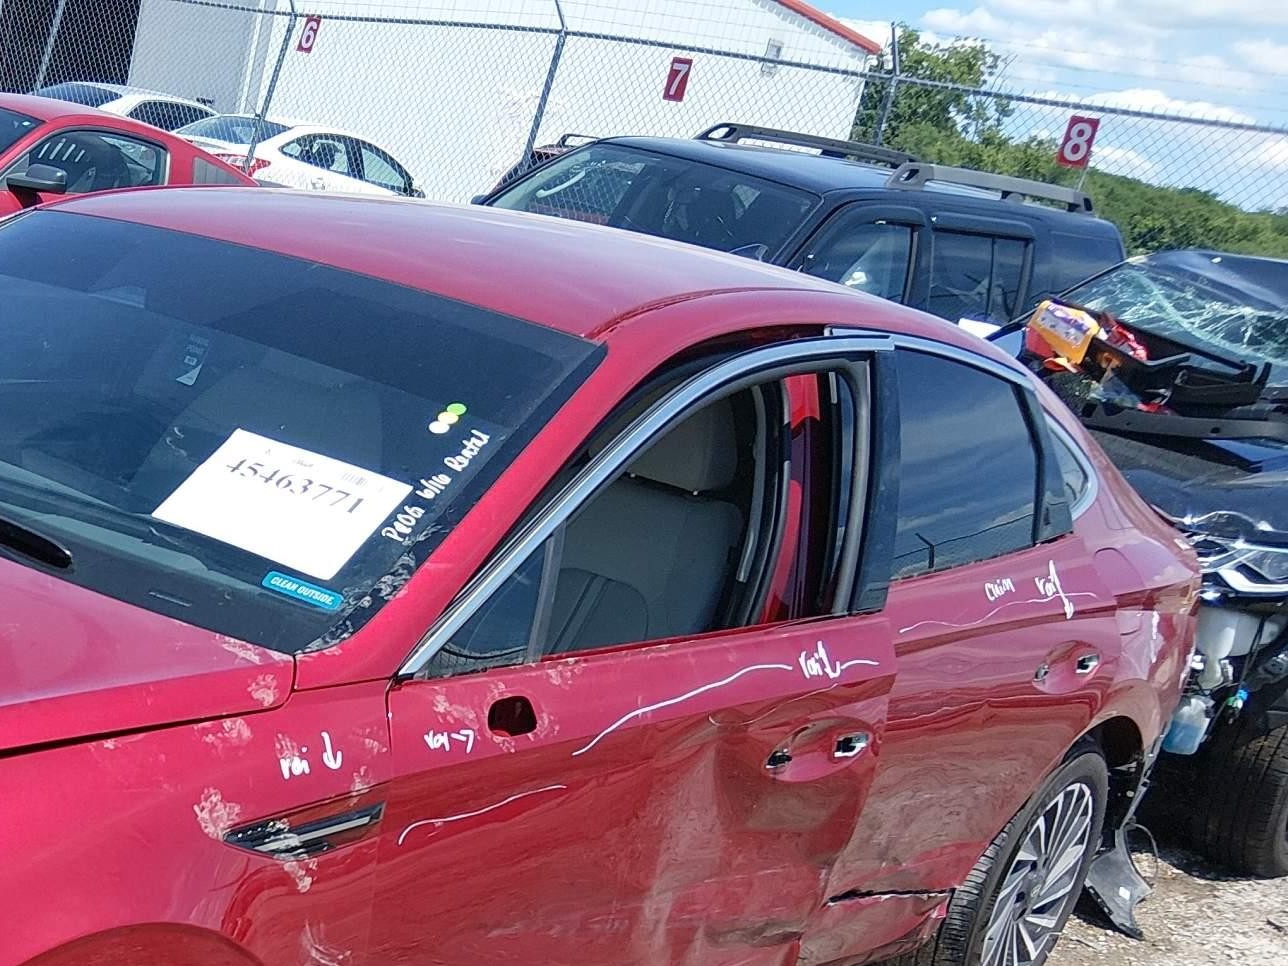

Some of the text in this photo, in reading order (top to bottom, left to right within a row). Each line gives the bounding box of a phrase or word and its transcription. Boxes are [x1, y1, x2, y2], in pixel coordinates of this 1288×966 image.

[301, 21, 317, 48] 6
[669, 63, 689, 96] 7
[1063, 122, 1092, 161] 8
[226, 459, 364, 514] 45463771
[270, 577, 335, 605] CLEAN OUTSIDE
